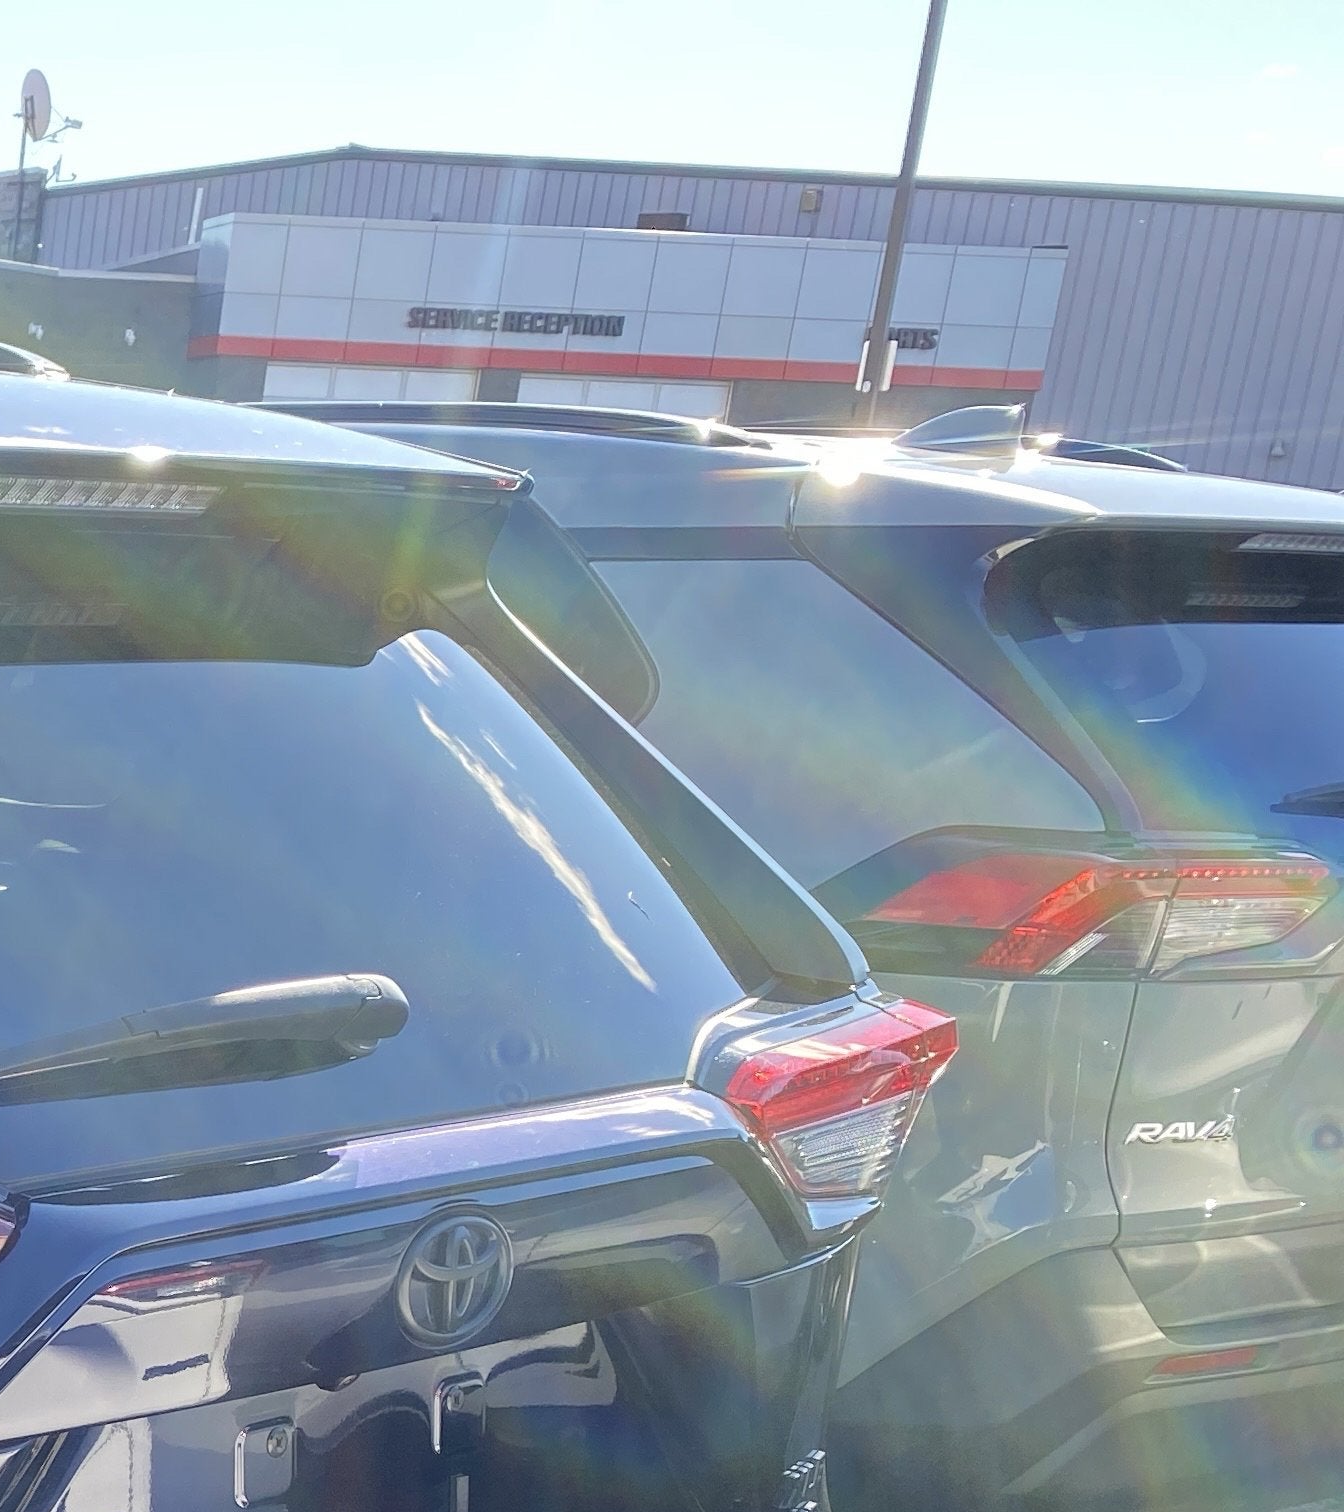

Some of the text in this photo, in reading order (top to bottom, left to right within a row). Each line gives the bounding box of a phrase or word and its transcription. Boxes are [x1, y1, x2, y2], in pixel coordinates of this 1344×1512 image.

[407, 307, 626, 337] SERVICE RECEPTION
[1124, 1115, 1235, 1145] RAV4
